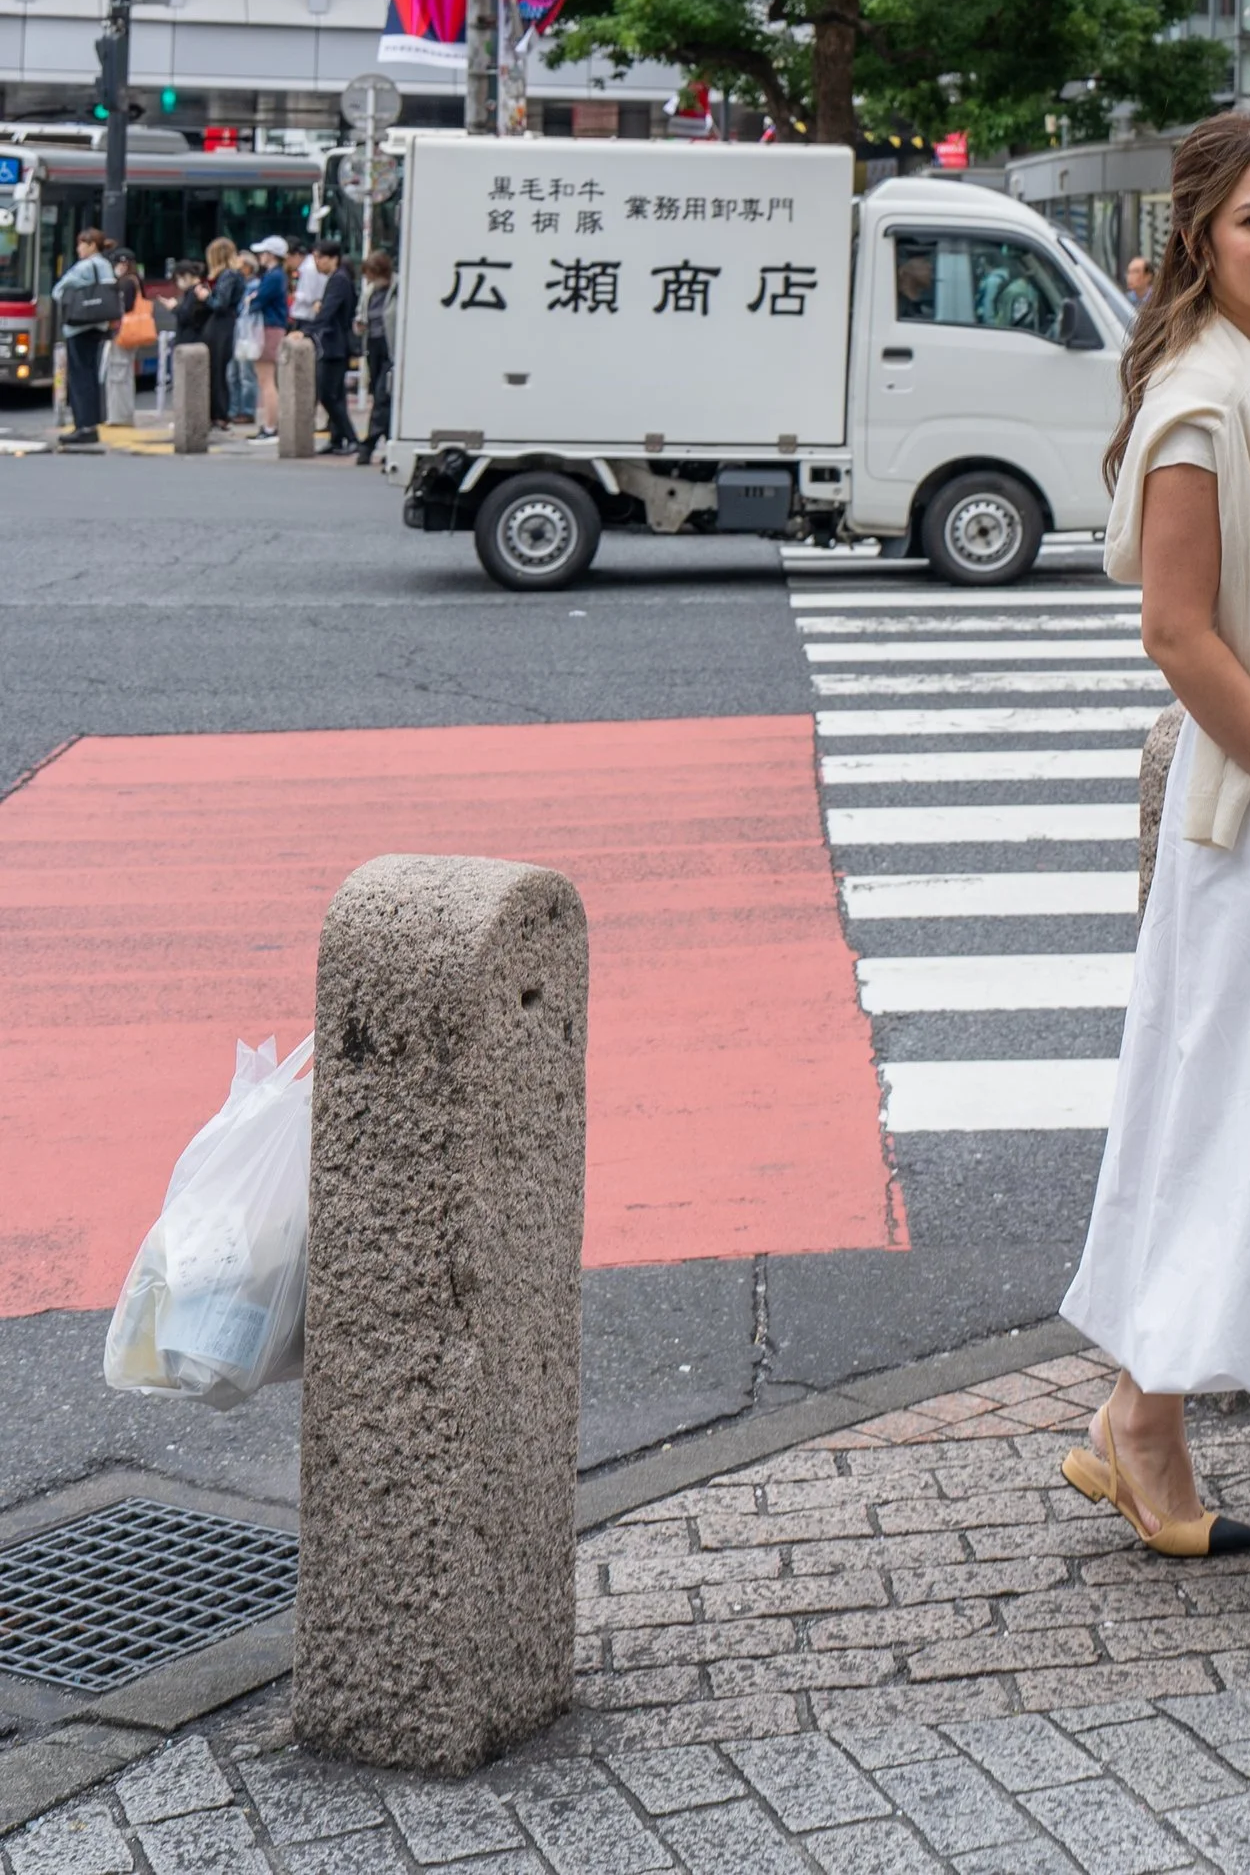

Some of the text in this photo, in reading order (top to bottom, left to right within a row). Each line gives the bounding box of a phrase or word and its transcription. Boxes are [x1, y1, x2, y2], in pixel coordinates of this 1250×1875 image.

[487, 176, 606, 203] 黒毛和牛
[487, 209, 604, 235] 銘柄豚
[623, 195, 795, 223] 業務用卸専門
[440, 256, 818, 317] 広瀬商店
